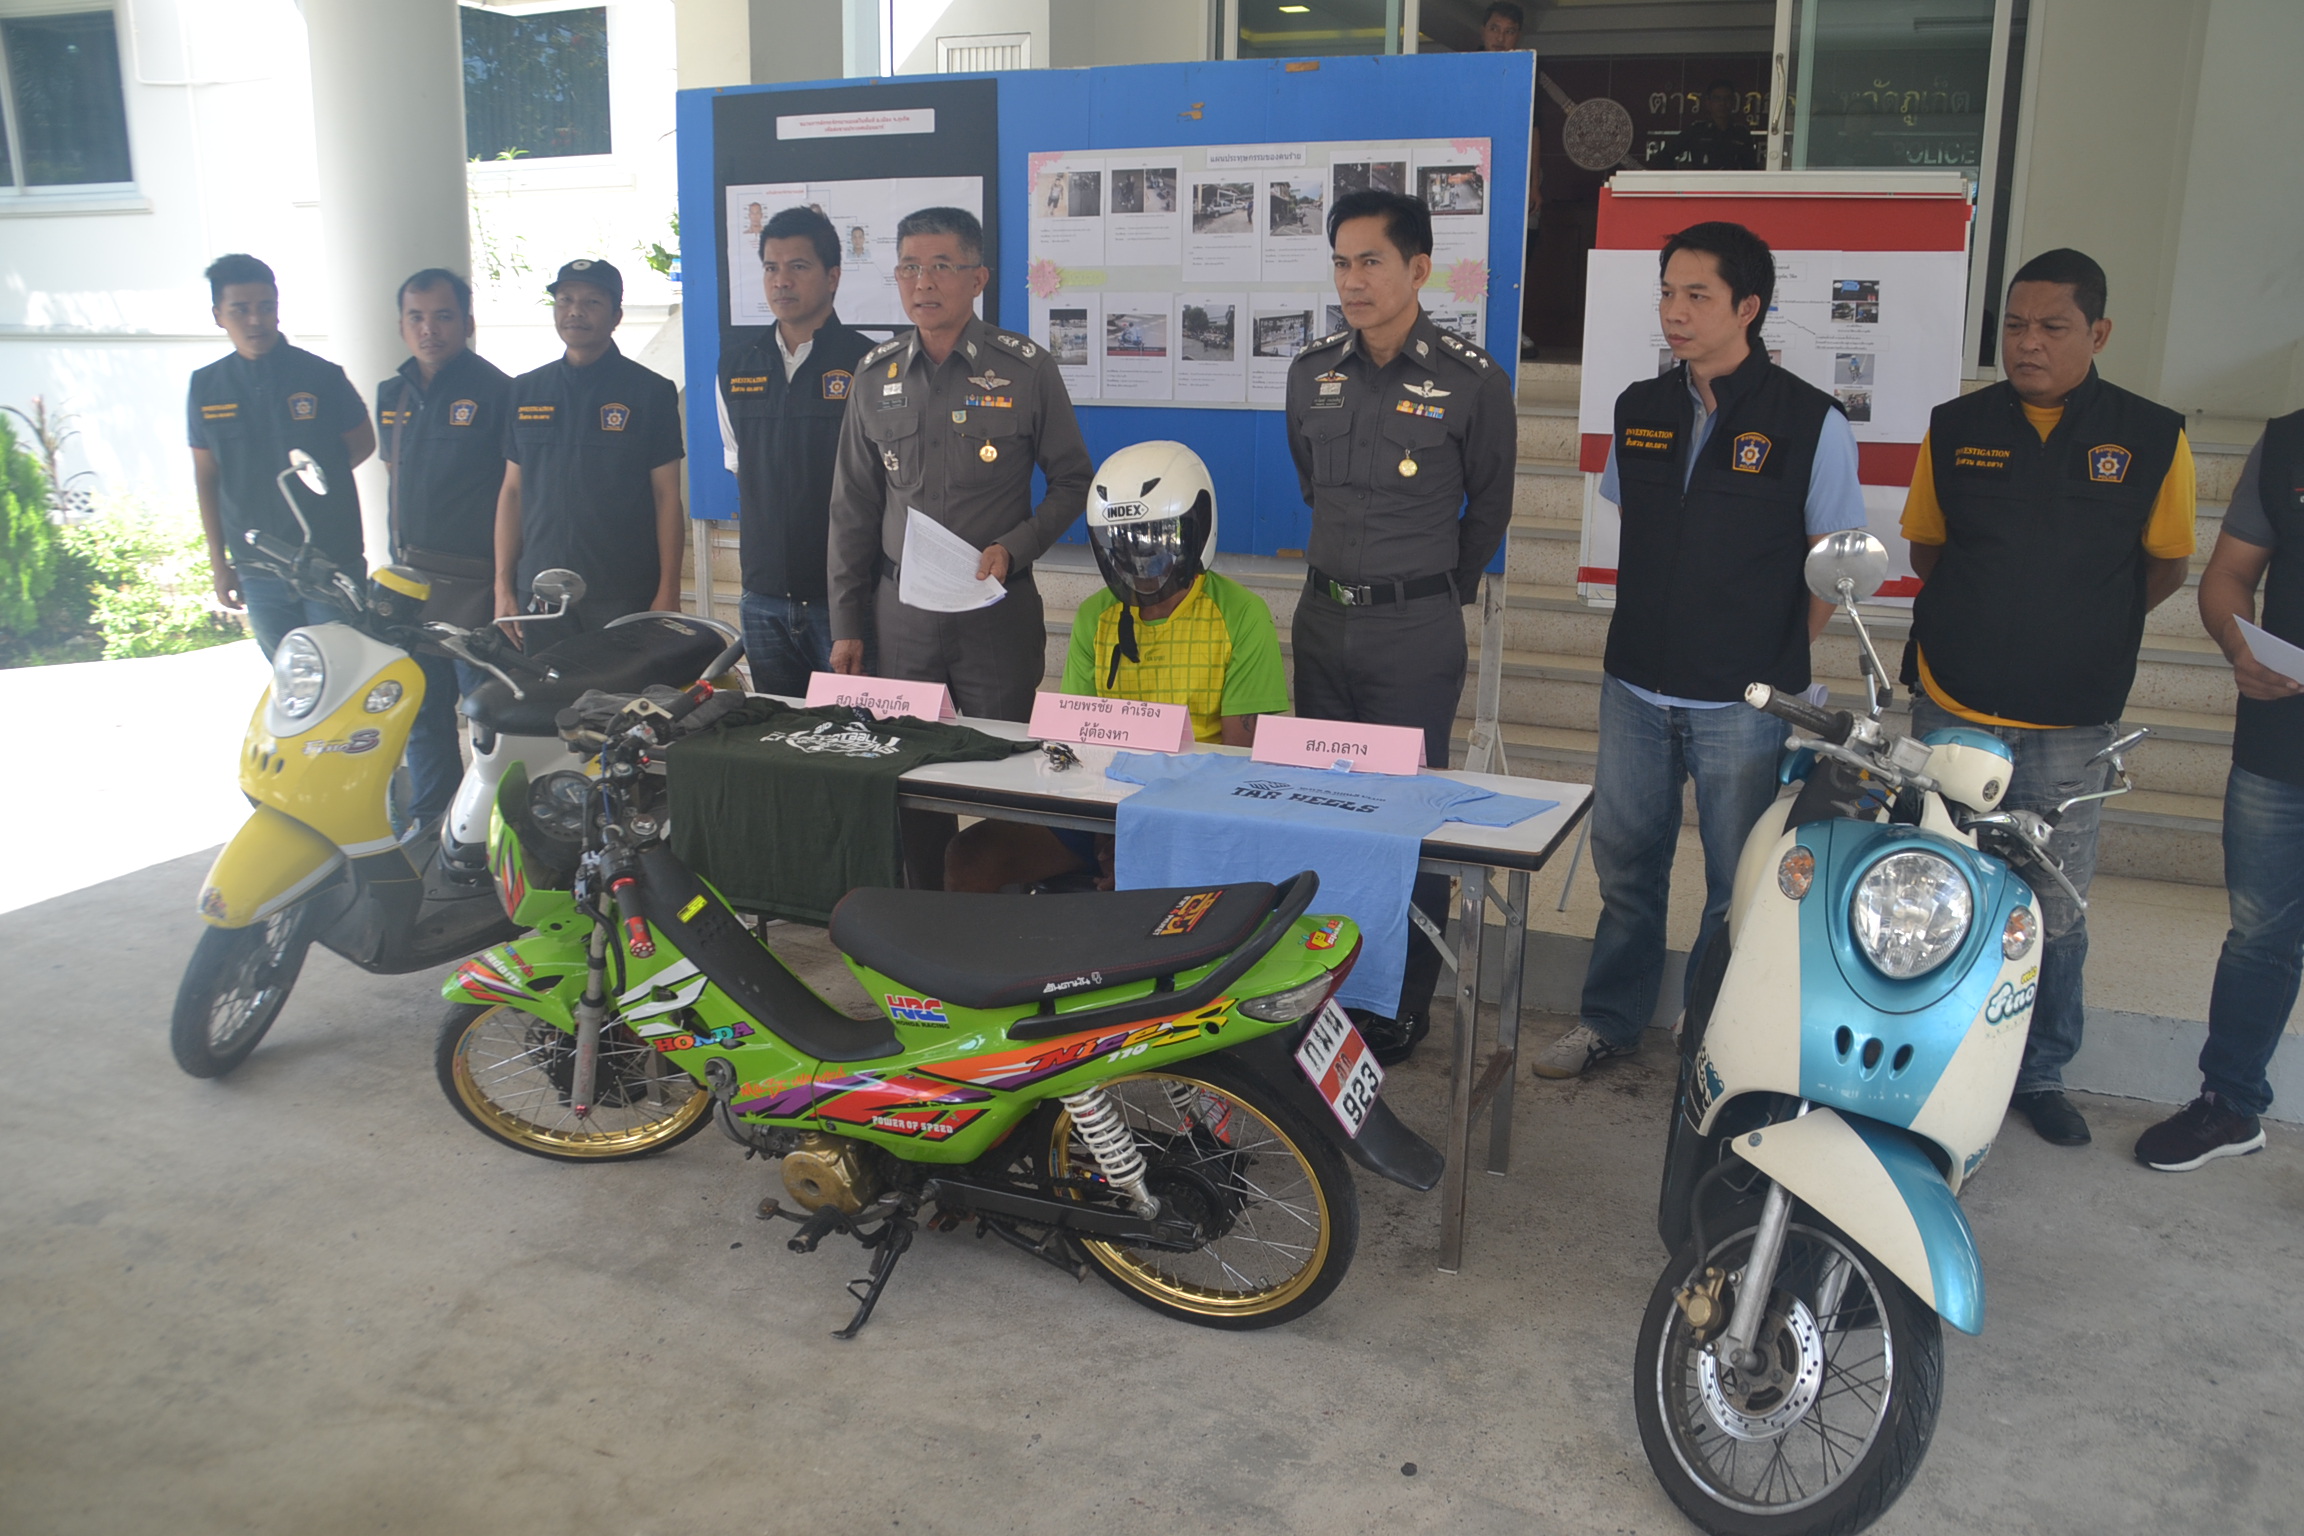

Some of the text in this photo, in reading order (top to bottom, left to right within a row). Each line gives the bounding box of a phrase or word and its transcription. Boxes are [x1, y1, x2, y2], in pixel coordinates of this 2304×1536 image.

[1625, 428, 1674, 439] INVESTIGATION
[1955, 446, 2011, 458] INVESTIGATION
[1107, 504, 1142, 519] INDEX
[836, 692, 910, 715] สภ.เมืองภูเก็ต
[1059, 698, 1113, 714] นายพรชัย
[1079, 721, 1129, 742] ผู้ต้องหา
[1305, 739, 1369, 756] สภ.ถลาง
[1231, 786, 1283, 800] TAR
[1288, 793, 1380, 813] HEELS
[884, 993, 949, 1023] HRC
[1985, 981, 2037, 1026] Fino
[652, 1021, 756, 1052] HONDA
[921, 1022, 951, 1030] RACING
[1107, 1043, 1149, 1064] 110
[1343, 1061, 1379, 1126] 923
[872, 1115, 955, 1134] POWER OF SPEED
